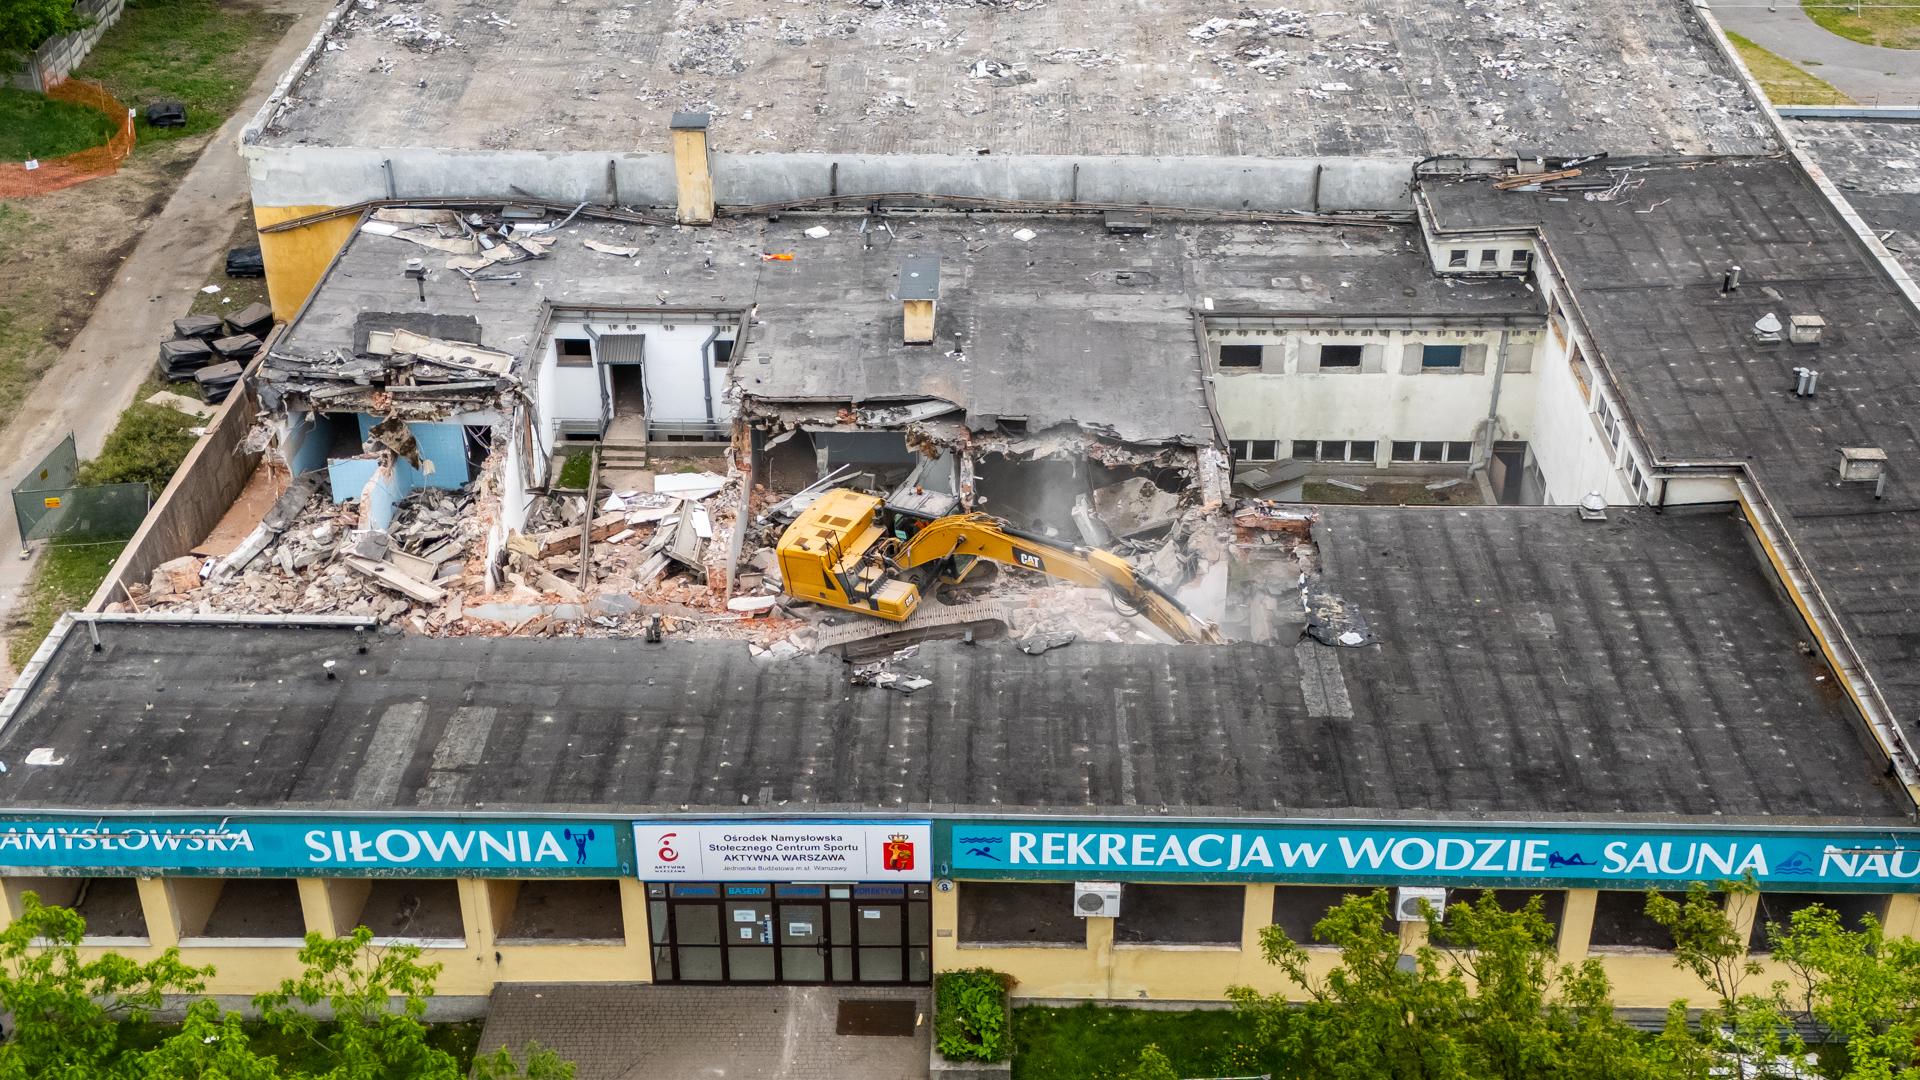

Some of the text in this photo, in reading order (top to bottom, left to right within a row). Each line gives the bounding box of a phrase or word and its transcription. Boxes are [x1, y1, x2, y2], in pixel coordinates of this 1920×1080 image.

[1020, 553, 1040, 568] CAT
[723, 834, 843, 843] Ośrodek Namysłowska
[304, 829, 569, 863] SIŁOWNIA
[775, 843, 821, 851] Centrum
[823, 843, 859, 853] Sportu
[1010, 831, 1550, 873] REKREACJA w WODZIE
[723, 854, 846, 862] AKTYWNA WARSZAWA
[1602, 841, 1769, 876] SAUNA
[728, 887, 767, 895] BASENY
[941, 883, 949, 891] 8
